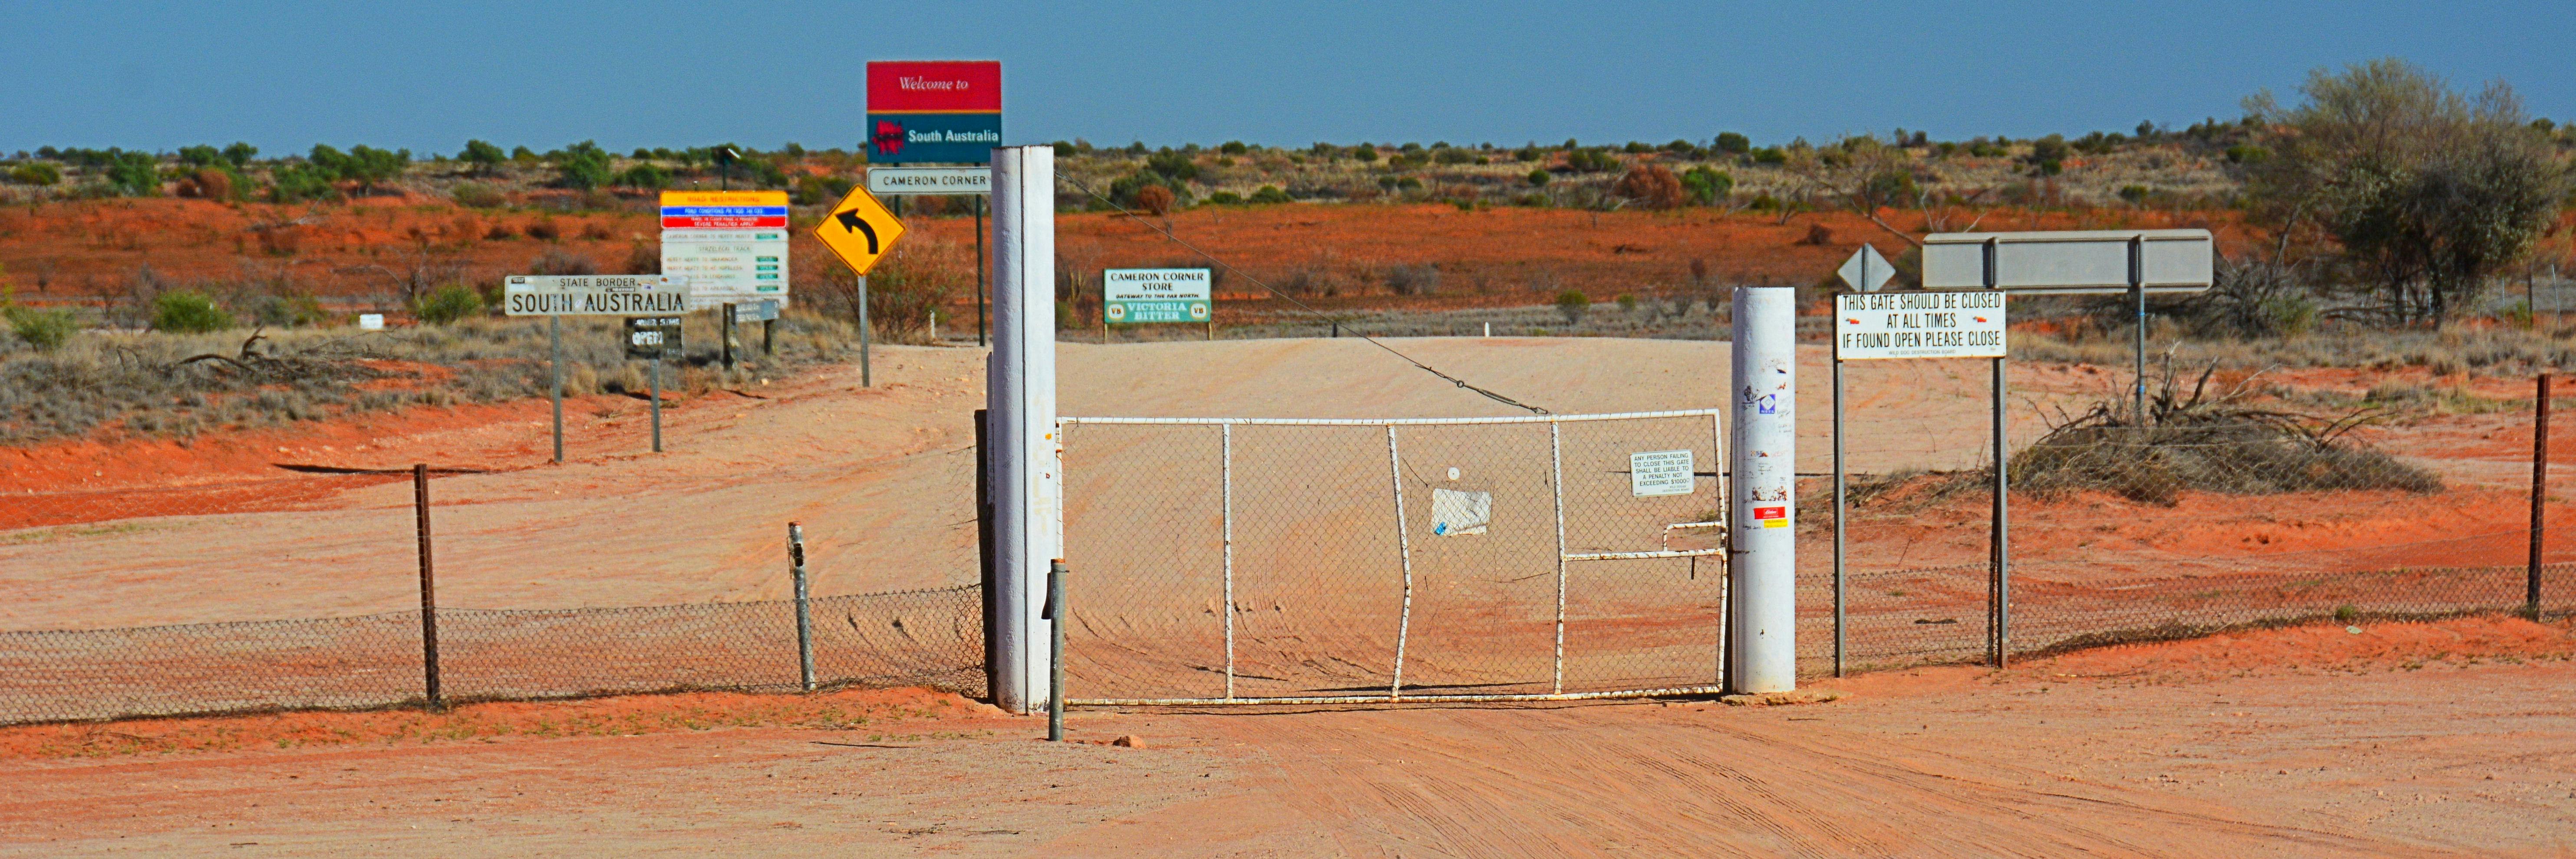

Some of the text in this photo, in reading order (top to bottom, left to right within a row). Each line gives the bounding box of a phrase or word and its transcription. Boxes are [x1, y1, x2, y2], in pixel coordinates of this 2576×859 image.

[900, 76, 969, 89] Welcome to
[909, 129, 998, 142] South Australia
[883, 176, 986, 185] CAMERON CORNER
[560, 278, 635, 287] STATE BORDER
[1142, 283, 1173, 291] STORE
[512, 293, 684, 312] SOUTH AUSTRALIA
[1127, 302, 1187, 311] VICTORIA
[1843, 293, 2000, 310] THIS GATE SHOULD BE CLOSED
[1134, 311, 1180, 320] BITTER
[1887, 313, 1956, 329] AT ALL TIMES
[632, 331, 663, 346] OPEN
[1843, 330, 2000, 348] IF FOUND OPEN PLEASE CLOSE
